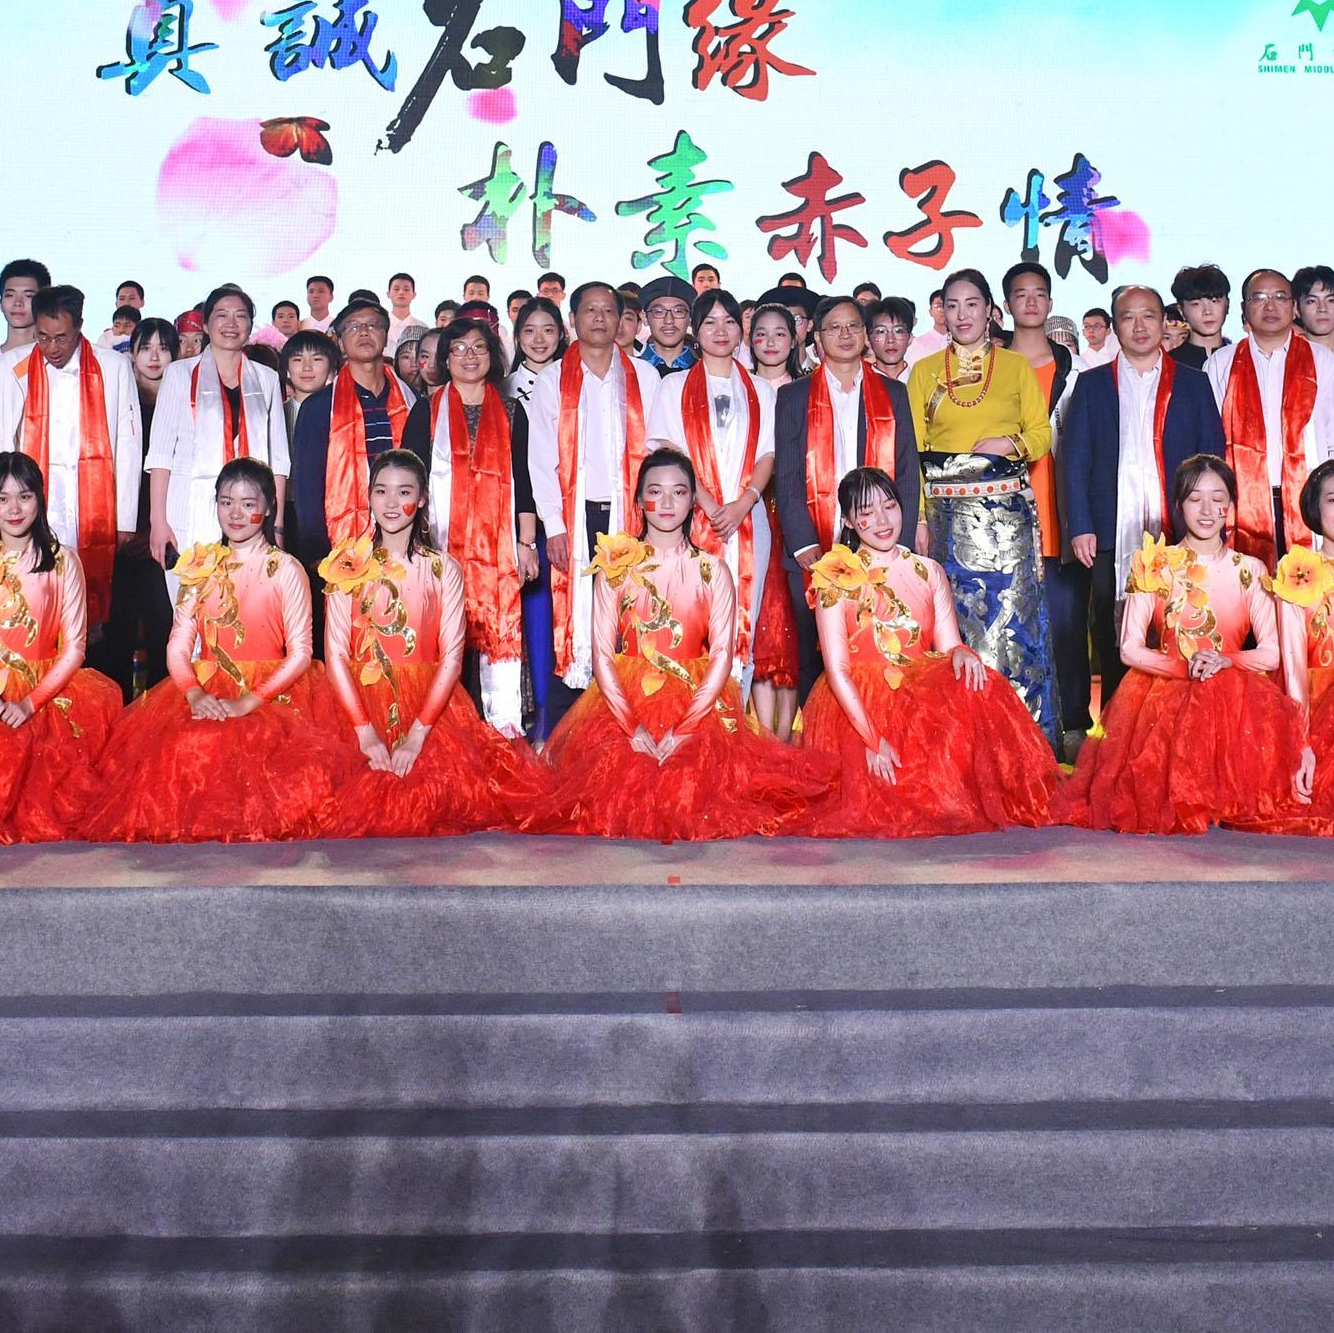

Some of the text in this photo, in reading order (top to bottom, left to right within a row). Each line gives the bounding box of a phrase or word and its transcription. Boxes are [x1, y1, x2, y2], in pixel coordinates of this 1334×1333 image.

[1258, 65, 1296, 74] SHIMEN
[457, 129, 1119, 284] 朴素赤子情
